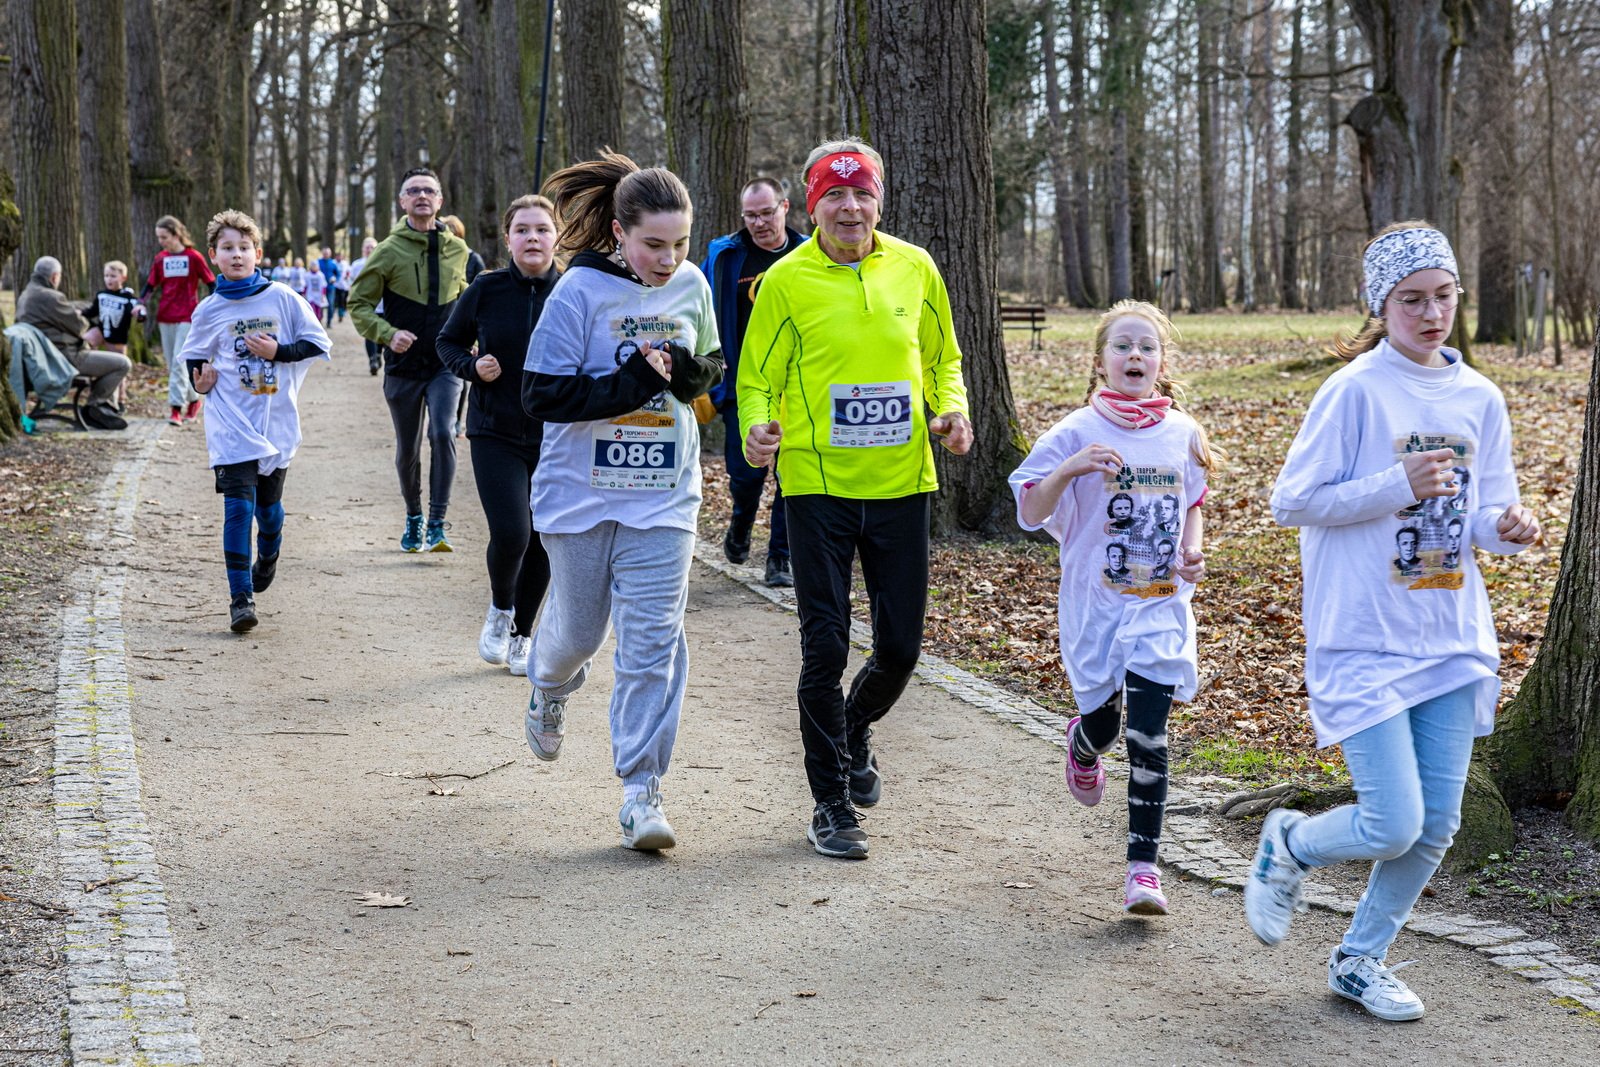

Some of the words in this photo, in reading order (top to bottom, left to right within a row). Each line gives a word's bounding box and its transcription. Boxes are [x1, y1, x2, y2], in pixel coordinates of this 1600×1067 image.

[640, 322, 675, 332] WILCZYM
[845, 398, 902, 424] 090
[606, 442, 665, 467] 086
[1138, 474, 1175, 486] WILCZYM
